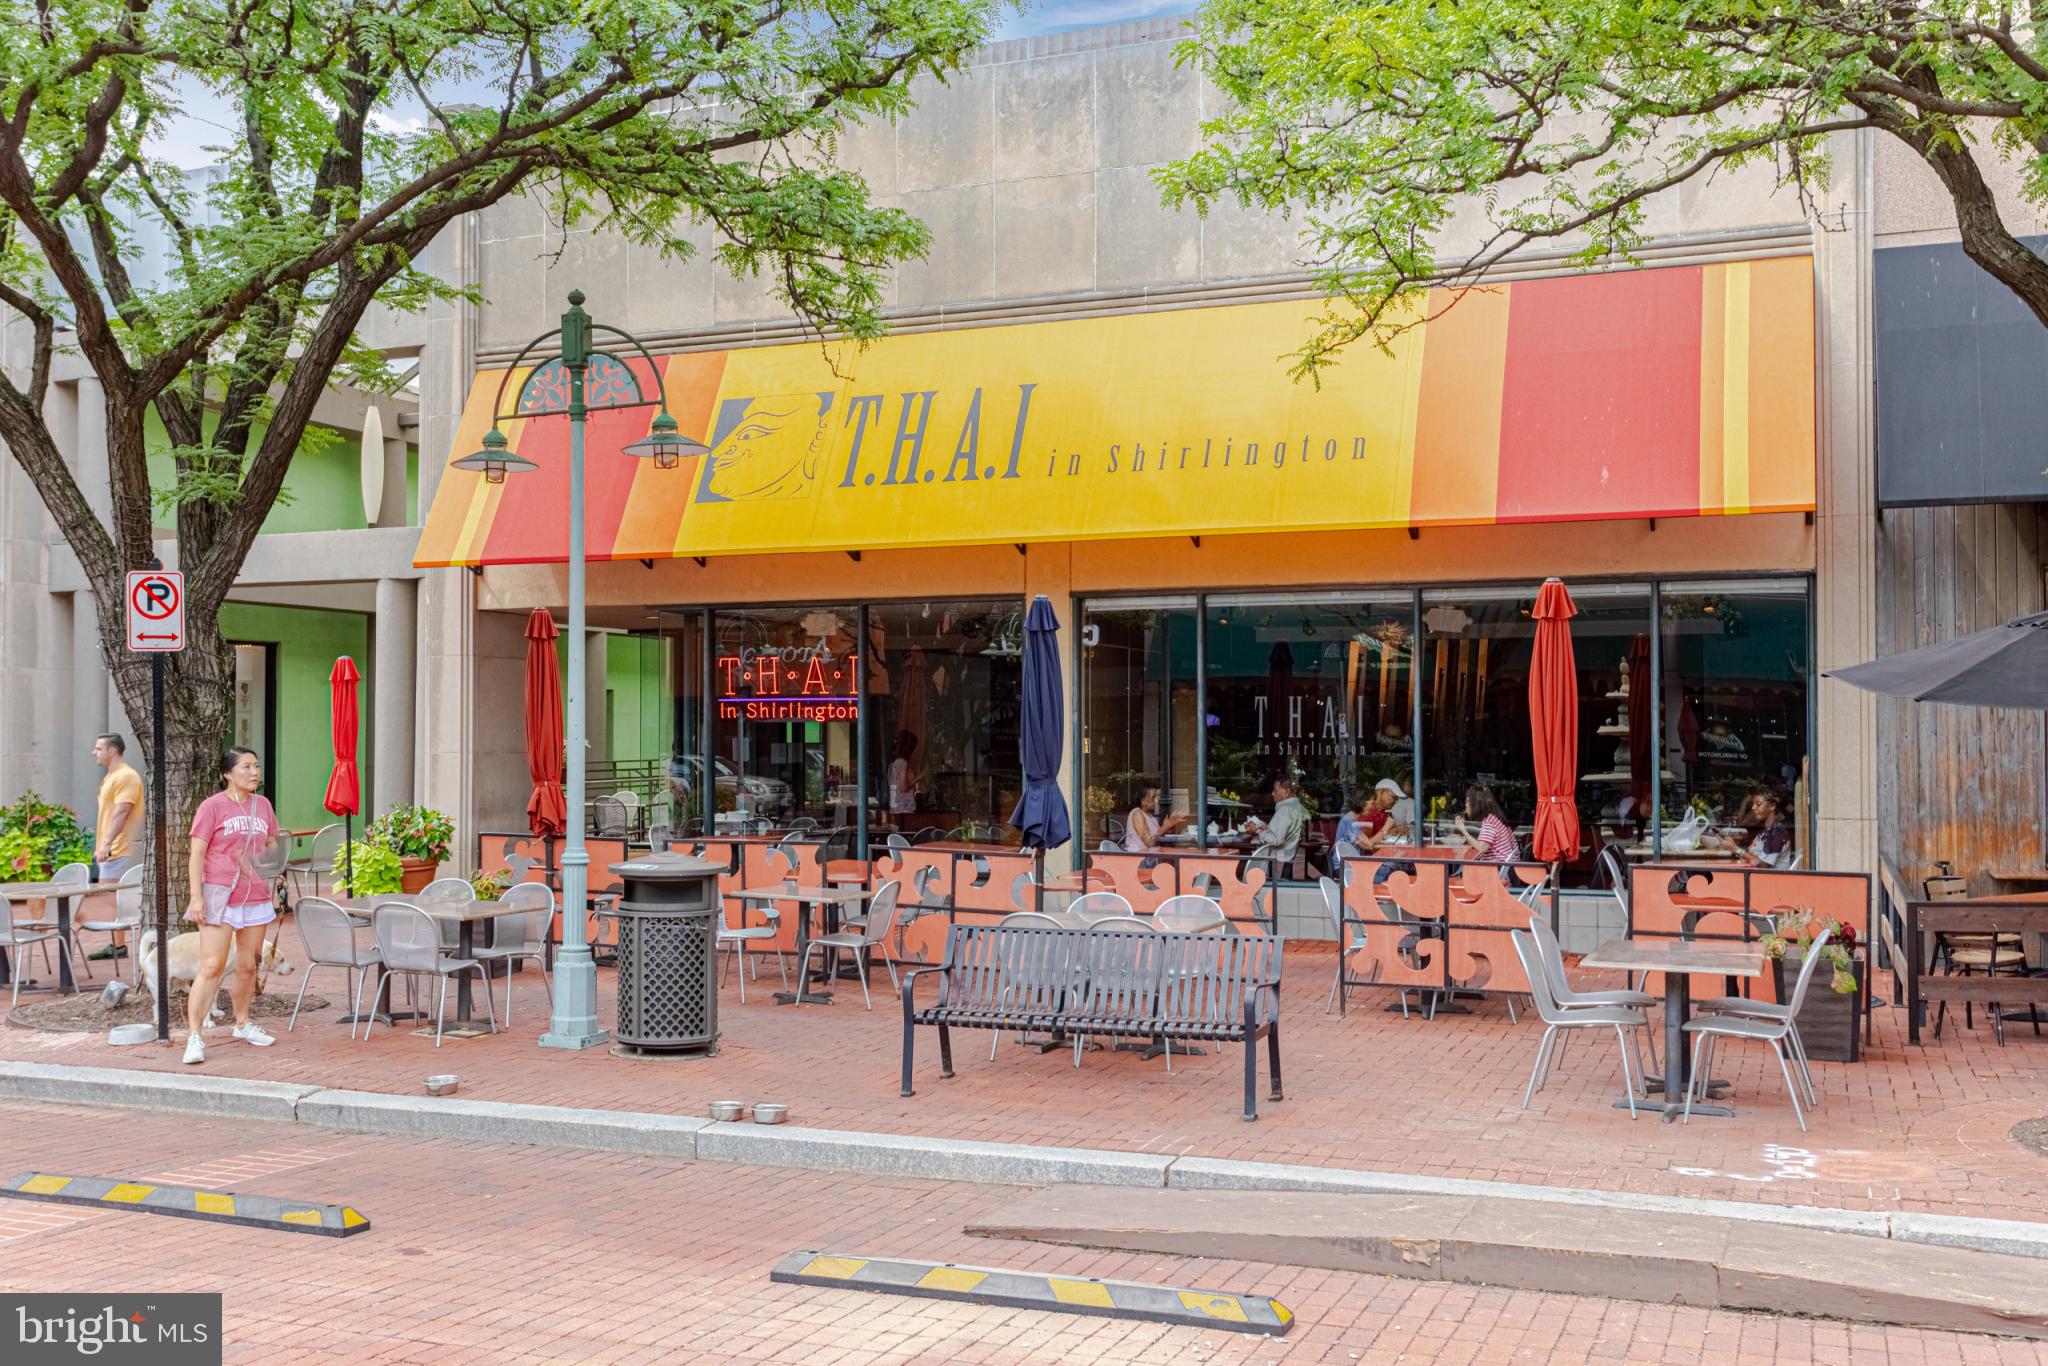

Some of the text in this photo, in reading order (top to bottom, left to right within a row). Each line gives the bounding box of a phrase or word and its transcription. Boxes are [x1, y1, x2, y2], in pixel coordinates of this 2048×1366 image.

[838, 383, 1366, 488] T.H.A.I in Shirlington
[746, 702, 859, 722] Shirlington
[1279, 740, 1365, 757] Shirlington
